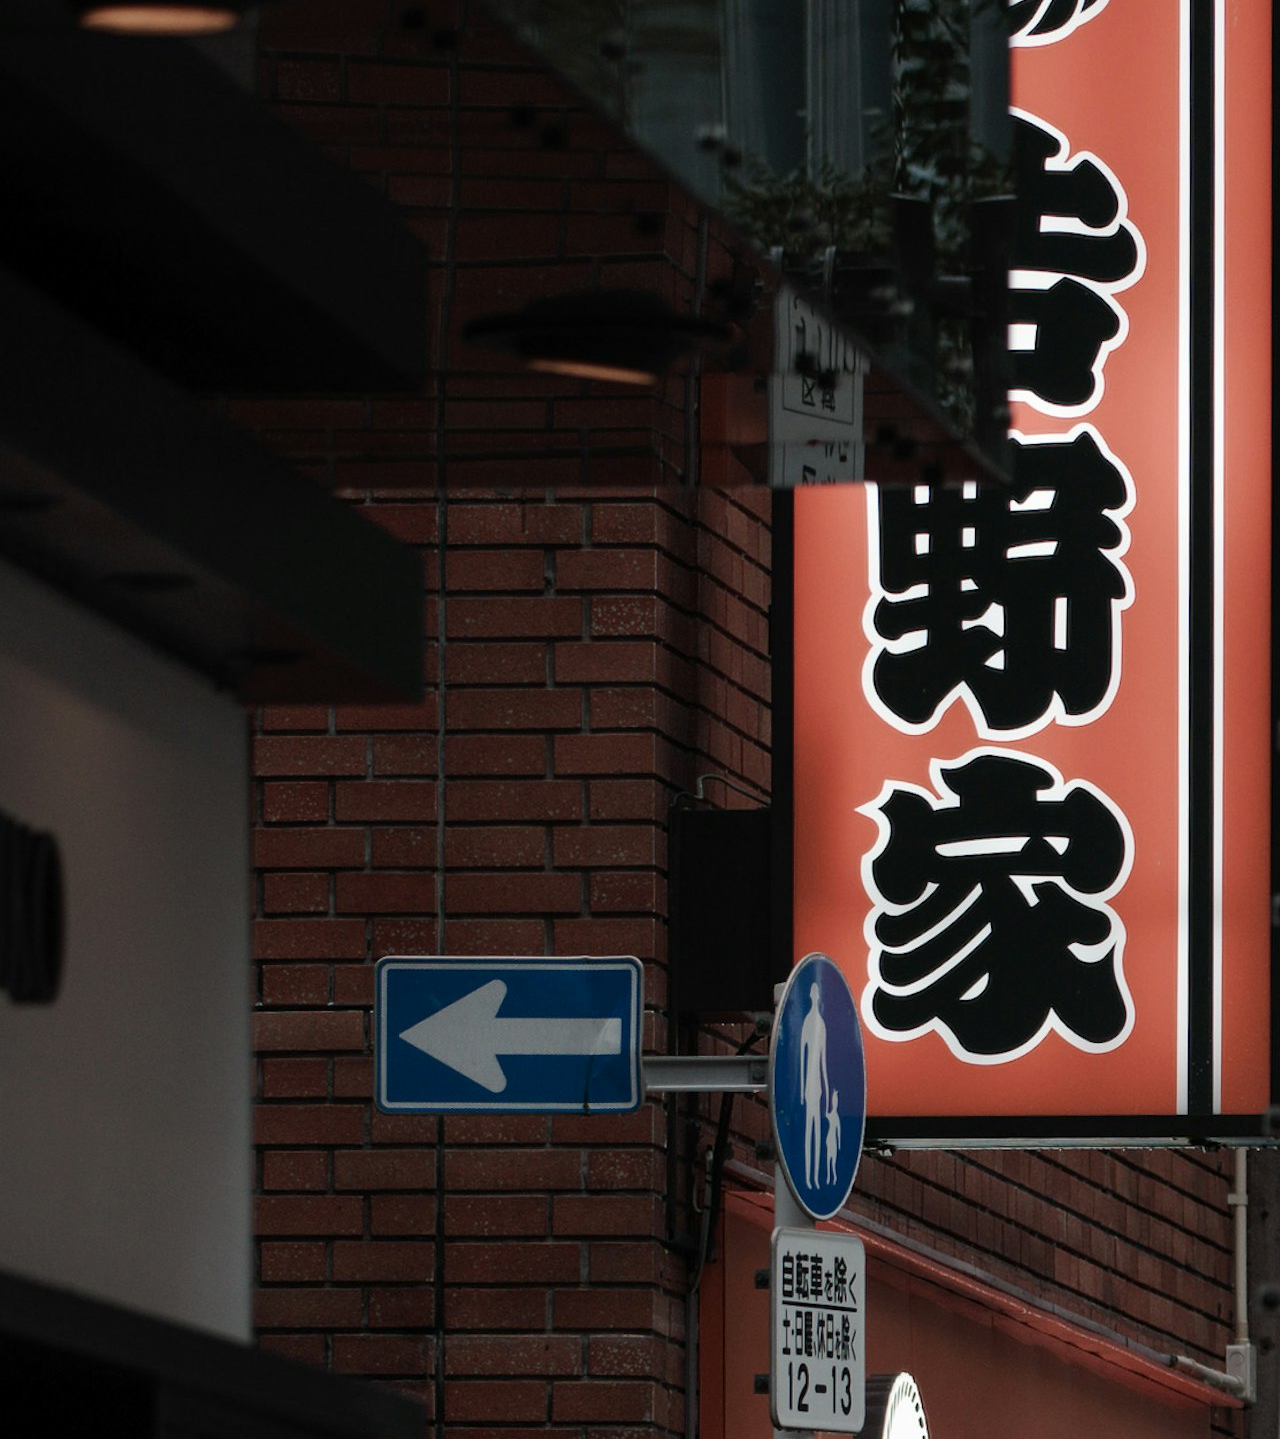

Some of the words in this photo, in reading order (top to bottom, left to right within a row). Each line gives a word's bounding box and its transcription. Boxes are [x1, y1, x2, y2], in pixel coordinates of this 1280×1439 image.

[782, 1251, 857, 1304] 自転車を除く
[787, 1361, 853, 1416] 12-13
